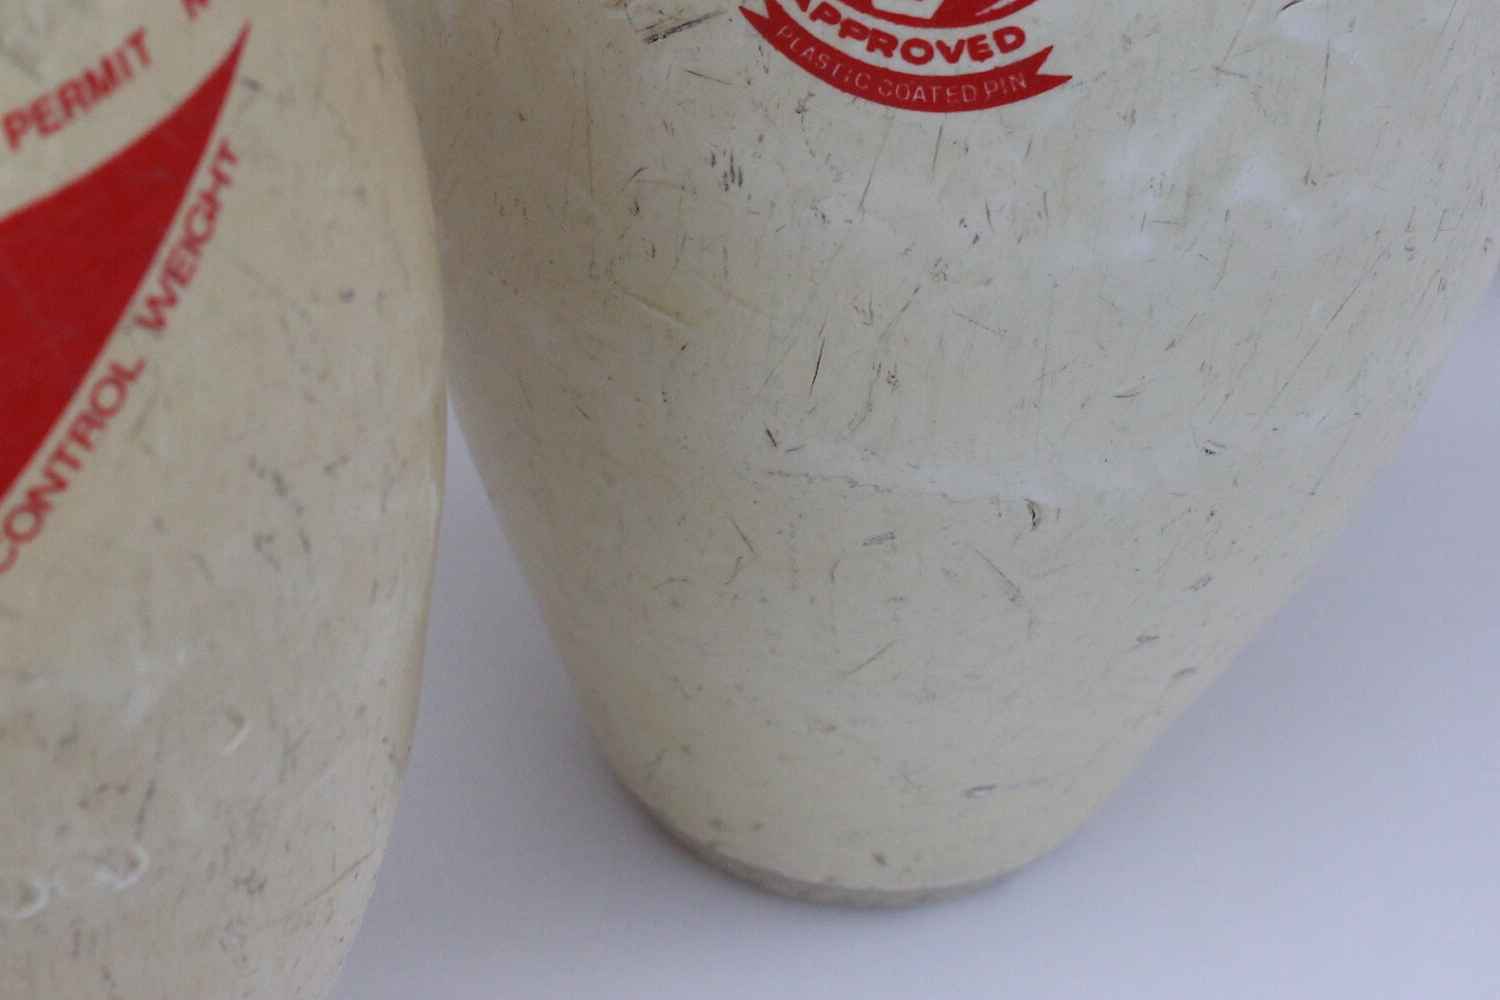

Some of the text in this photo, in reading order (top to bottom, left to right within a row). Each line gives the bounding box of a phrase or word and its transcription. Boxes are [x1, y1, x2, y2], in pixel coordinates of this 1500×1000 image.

[2, 26, 151, 151] PERMIT
[776, 24, 1028, 104] PLASTIC COATED PIN
[136, 137, 240, 334] WEIGHT
